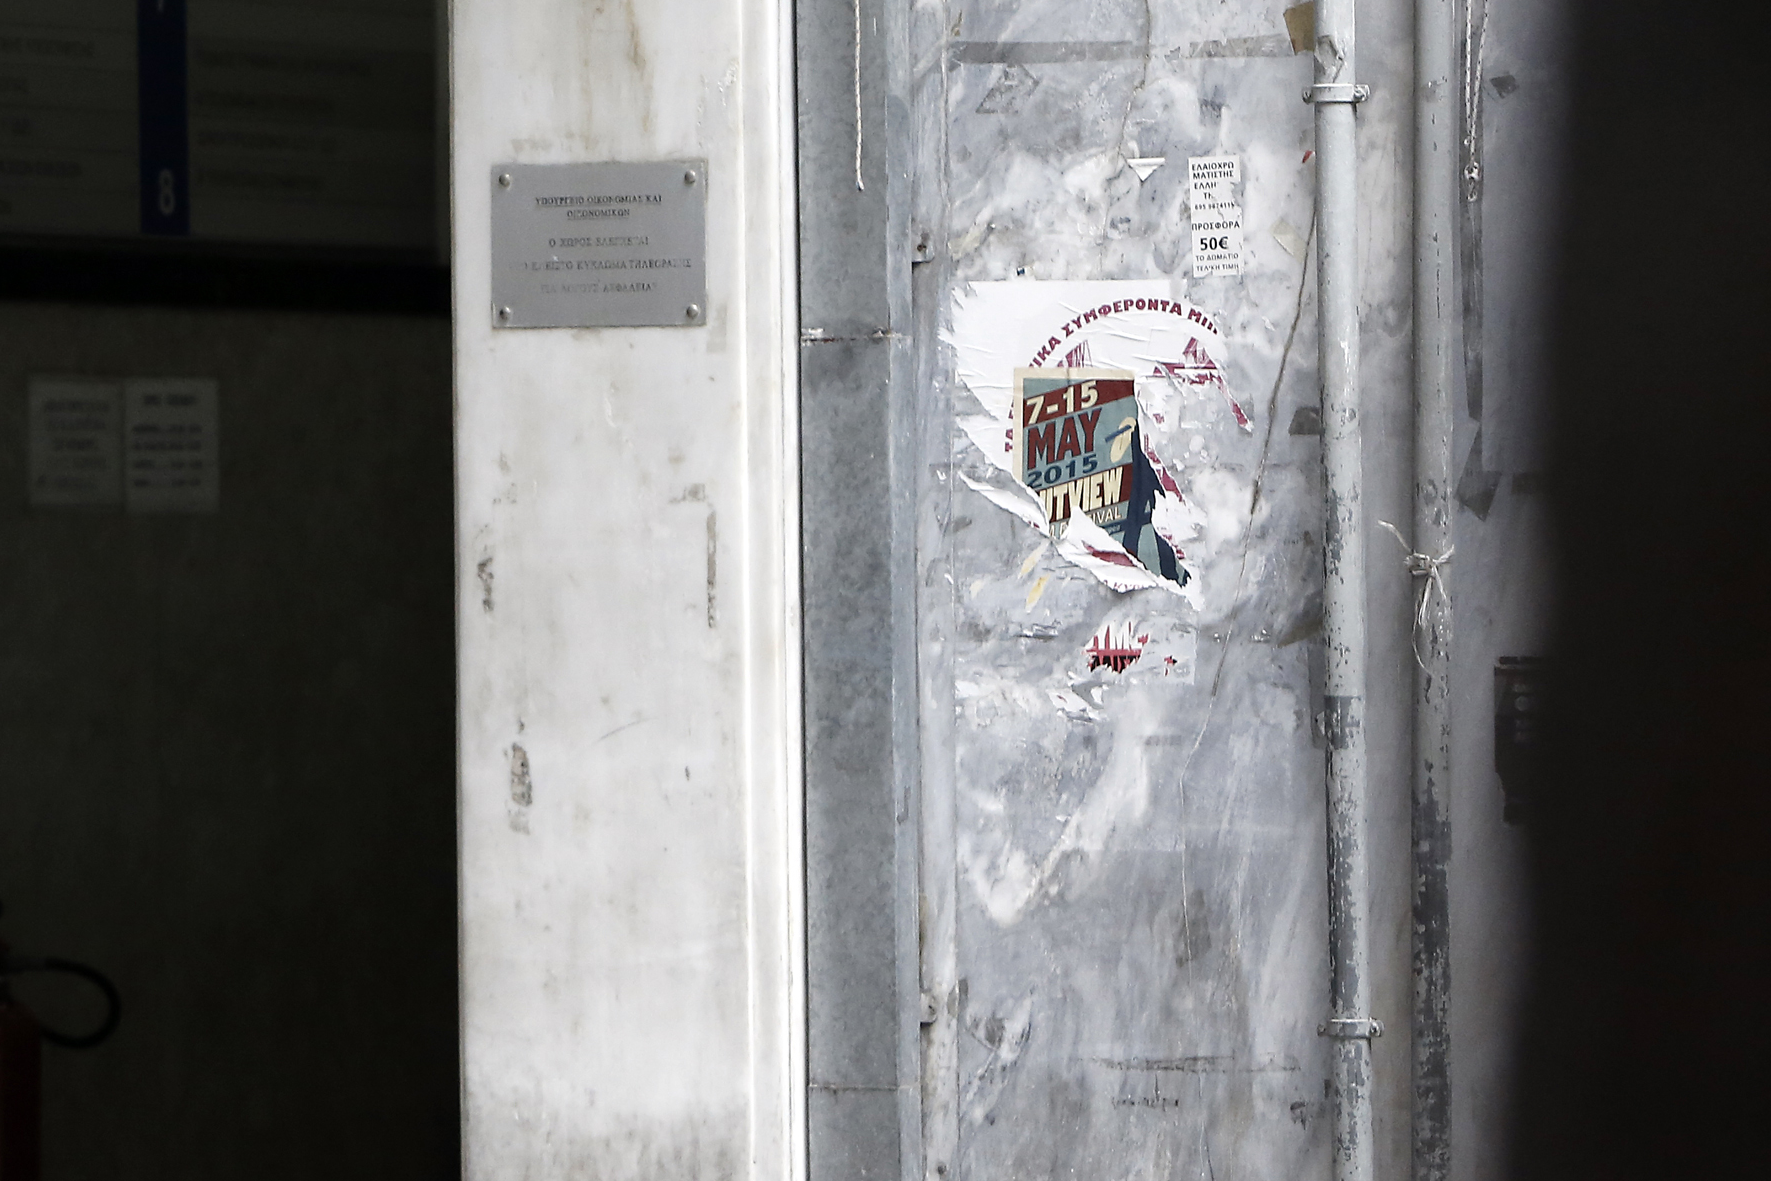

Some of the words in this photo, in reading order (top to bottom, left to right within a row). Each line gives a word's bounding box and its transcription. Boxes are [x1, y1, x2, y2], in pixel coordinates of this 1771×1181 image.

[1191, 161, 1234, 172] ΕΛΑΙΟΧΡΩ
[1192, 170, 1234, 180] ΜΑΤΙΣΤΗΣ
[158, 168, 175, 216] 8
[645, 194, 662, 203] ΚΑΙ
[1191, 220, 1240, 231] ΠΡΟΣΦΟΡΑ
[1200, 236, 1228, 251] 50€
[1062, 298, 1182, 337] ΣΥΜΦΕΡΟΝΤΑ
[1026, 381, 1098, 424] 7-15
[1027, 408, 1102, 470] MAY
[1028, 454, 1097, 488] 2015
